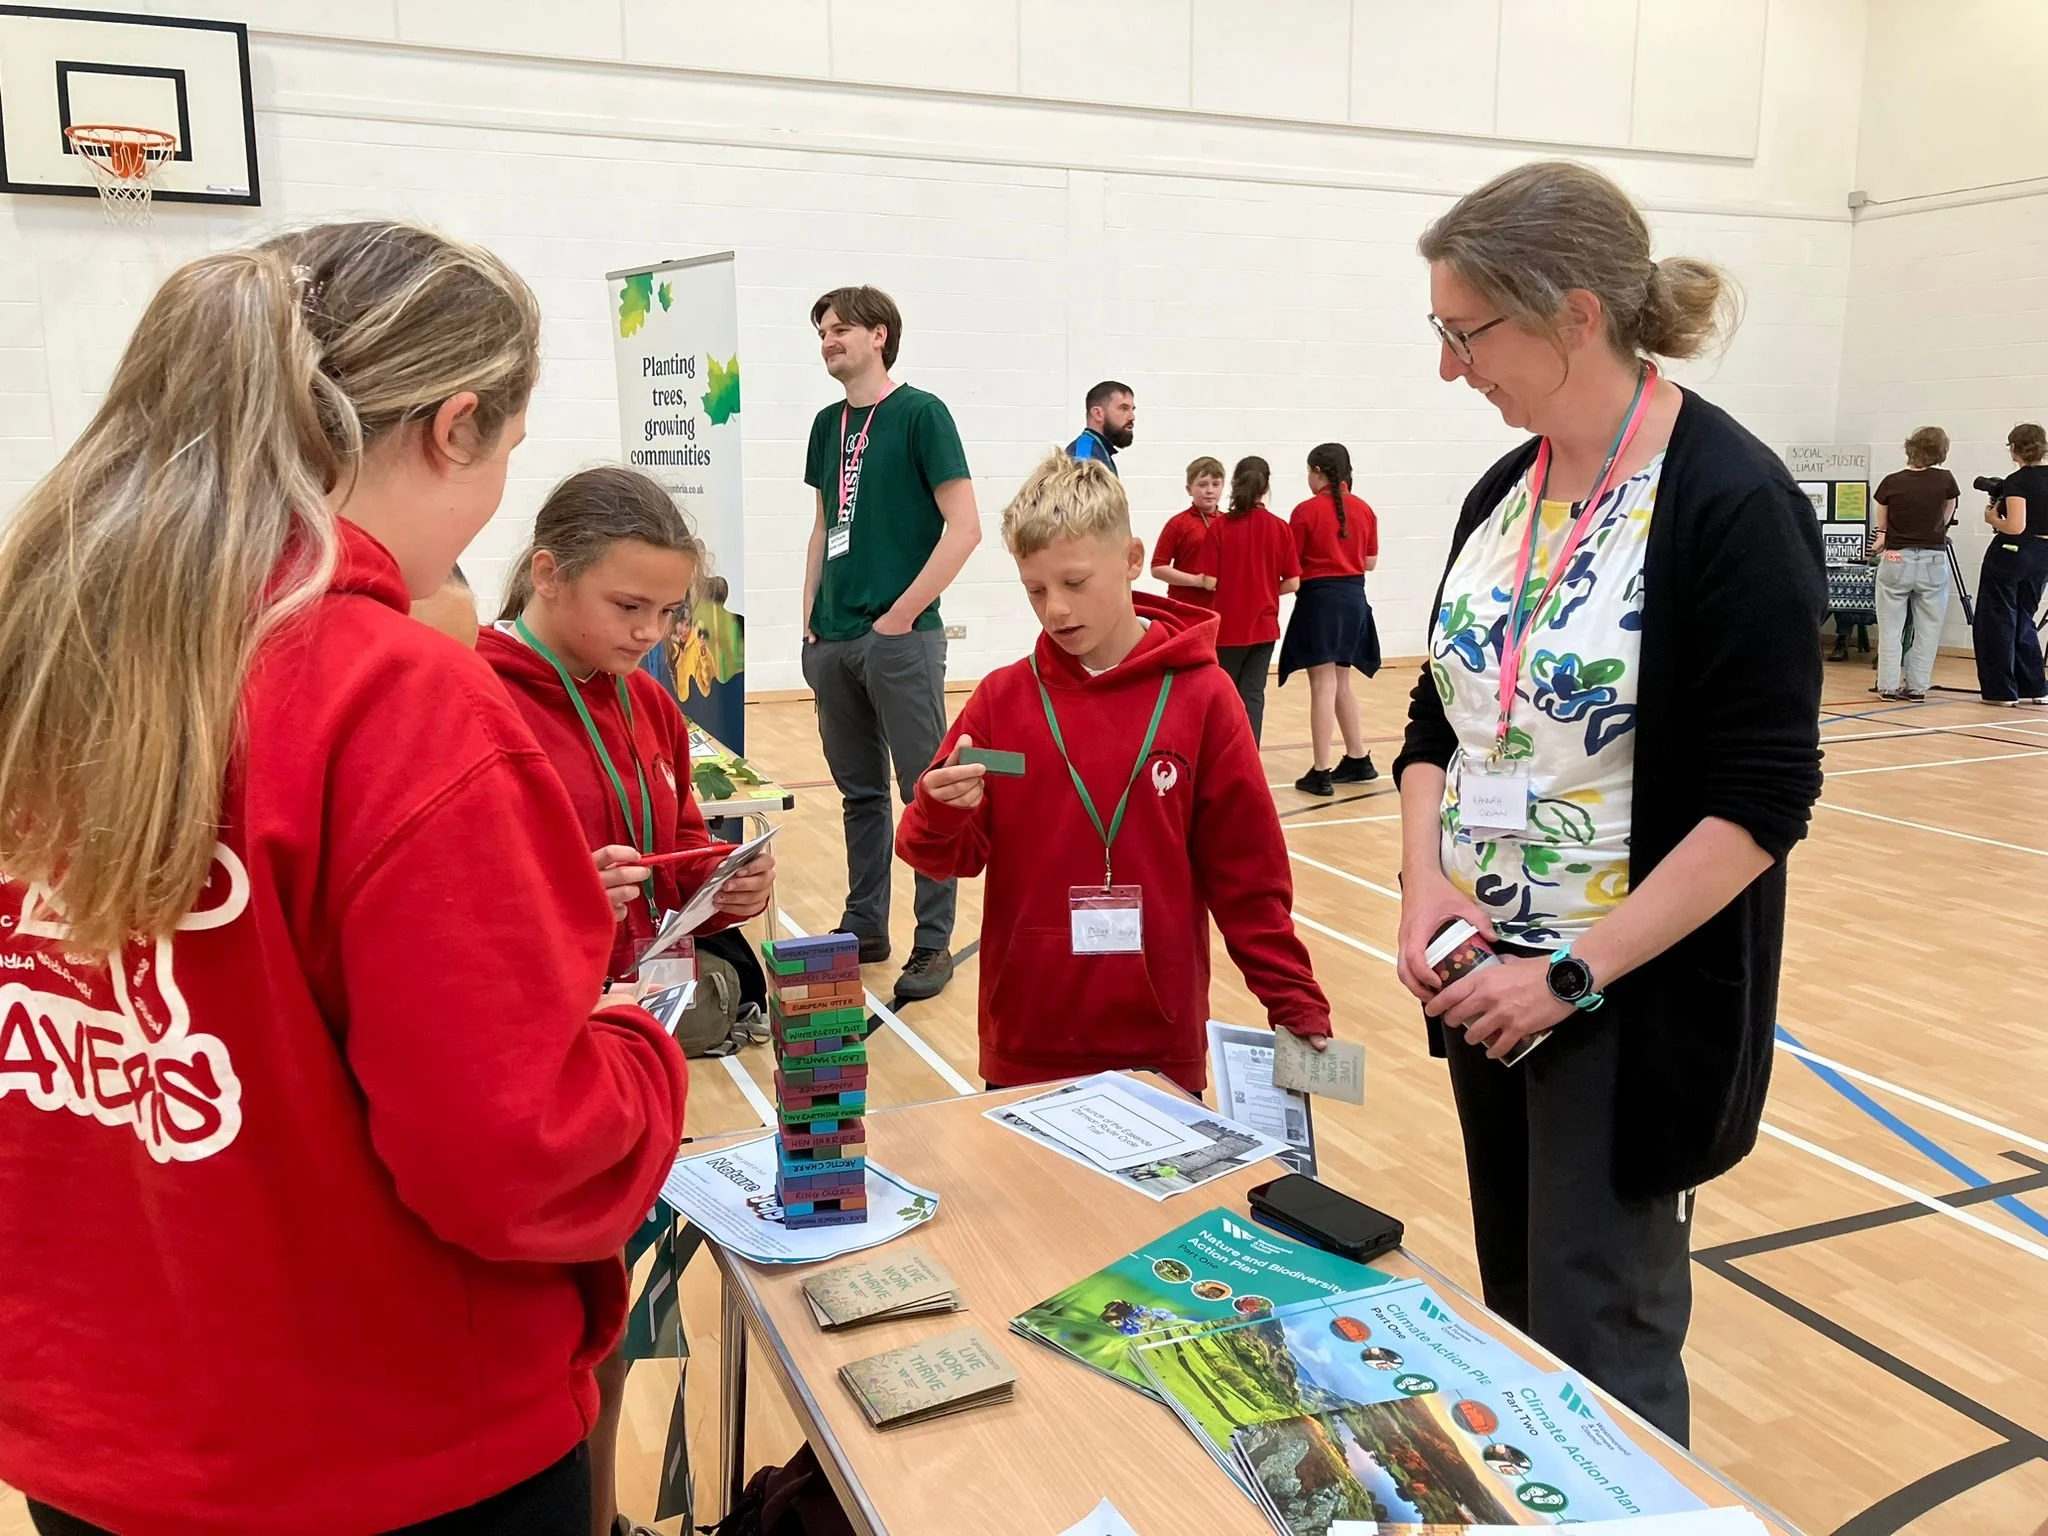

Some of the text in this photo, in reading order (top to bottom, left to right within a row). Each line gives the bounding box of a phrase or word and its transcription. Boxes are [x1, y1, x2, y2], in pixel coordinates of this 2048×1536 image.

[643, 353, 696, 379] Planting
[652, 388, 687, 408] trees,
[644, 414, 696, 441] growing
[630, 444, 711, 466] communities
[1793, 448, 1822, 458] SOCIAL
[1831, 454, 1866, 468] JUSTICE
[1792, 462, 1825, 473] CLIMATE
[1826, 545, 1862, 556] NOTHING
[1828, 536, 1860, 544] BUY
[822, 971, 854, 980] PLOVER
[792, 998, 854, 1012] EUROPEAN OTTER
[790, 1028, 842, 1040] WINTERGREEN
[795, 1056, 831, 1066] MANTLE
[1310, 1051, 1320, 1084] HRIVE
[1328, 1054, 1338, 1085] WORK
[792, 1134, 856, 1148] HEN HARRIER
[706, 1158, 760, 1192] Nature
[793, 1160, 856, 1172] ARCTIC CHARR
[1178, 1244, 1219, 1270] Part One
[1188, 1237, 1259, 1276] Action Plan
[1198, 1230, 1348, 1295] Nature and Biodiversity
[858, 1270, 892, 1300] THRIVE
[882, 1265, 912, 1292] WORK
[902, 1264, 928, 1283] LIVE
[1371, 1307, 1406, 1340] Part One
[1386, 1304, 1430, 1342] Climate
[1428, 1342, 1470, 1371] Action
[936, 1348, 970, 1380] WORK
[958, 1347, 986, 1371] LIVE
[910, 1354, 946, 1392] THRIVE
[1502, 1390, 1538, 1436] Part Two
[1520, 1388, 1641, 1514] Climate Action Plan
